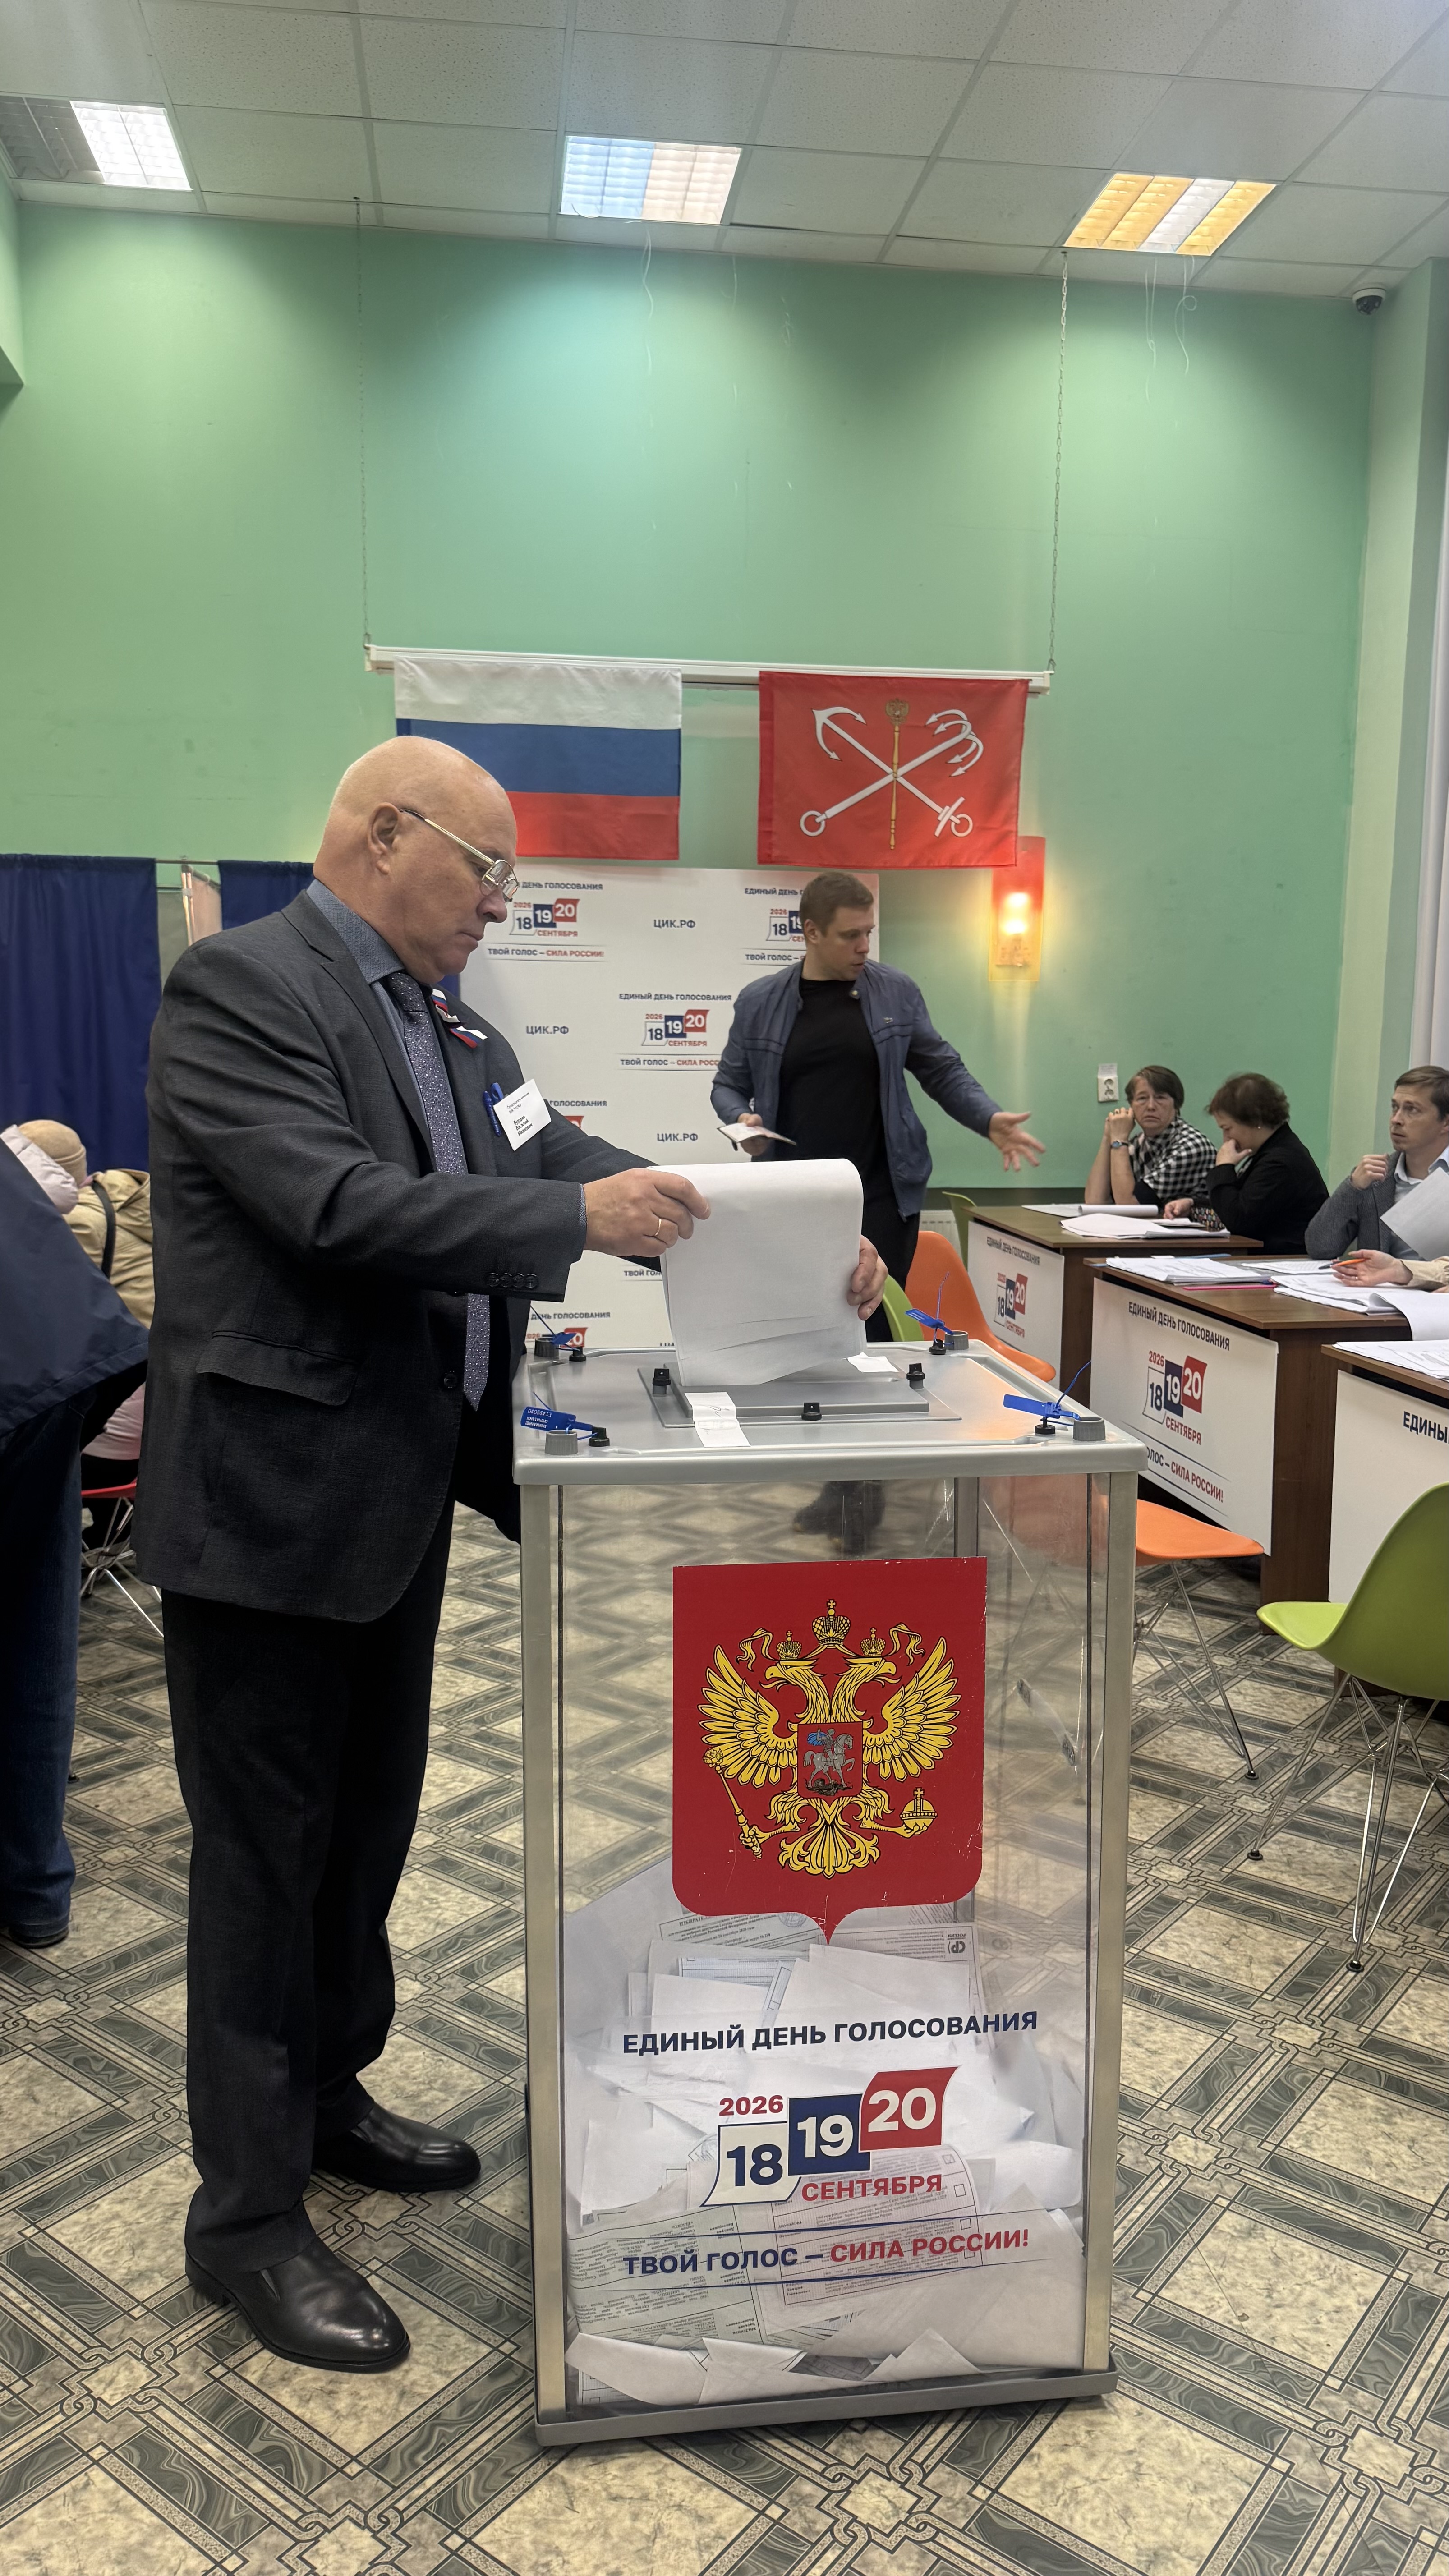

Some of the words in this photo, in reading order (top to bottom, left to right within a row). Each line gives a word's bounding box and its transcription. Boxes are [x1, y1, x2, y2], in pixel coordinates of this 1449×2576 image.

[516, 917, 532, 930] 18
[535, 910, 552, 923] 19
[555, 904, 575, 917] 20
[653, 919, 696, 929] ЦИК.РФ
[773, 923, 787, 936] 18
[488, 948, 510, 956] ТВОЙ
[526, 1026, 569, 1035] ЦИК.РФ
[648, 1028, 663, 1040] 18
[666, 1021, 683, 1034] 19
[685, 1014, 705, 1028] 20
[657, 1133, 698, 1142] ЦИК.РФ
[998, 1296, 1005, 1317] 18
[1007, 1288, 1014, 1311] 19
[1015, 1282, 1025, 1306] 20
[1128, 1302, 1157, 1322] ЕДИНЫЙ
[1158, 1311, 1177, 1329] ДЕНЬ
[1178, 1319, 1230, 1351] ГОЛОСОВАНИЯ
[1148, 1350, 1164, 1367] 2026
[1150, 1382, 1163, 1412] 18
[1166, 1374, 1181, 1405] 19
[1183, 1367, 1202, 1400] 20
[1165, 1416, 1201, 1445] СЕНТЯБРЯ
[1403, 1410, 1449, 1444] ЕДИНЫ
[1146, 1446, 1164, 1467] ОЛОС
[1171, 1461, 1190, 1483] СИЛА
[1191, 1472, 1224, 1503] РОССИИ!
[623, 2024, 743, 2055] ЕДИНЫЙ
[752, 2026, 826, 2050] ДЕНЬ
[834, 2010, 1037, 2042] ГОЛОСОВАНИЯ
[719, 2095, 784, 2116] 2026
[727, 2144, 782, 2187] 18
[797, 2114, 854, 2158] 19
[868, 2087, 937, 2133] 20
[801, 2174, 943, 2202] СЕНТЯБРЯ
[623, 2250, 698, 2276] ТВОЙ
[707, 2248, 798, 2272] ГОЛОС
[831, 2240, 904, 2263] СИЛА
[912, 2229, 1029, 2256] РОССИИ!
